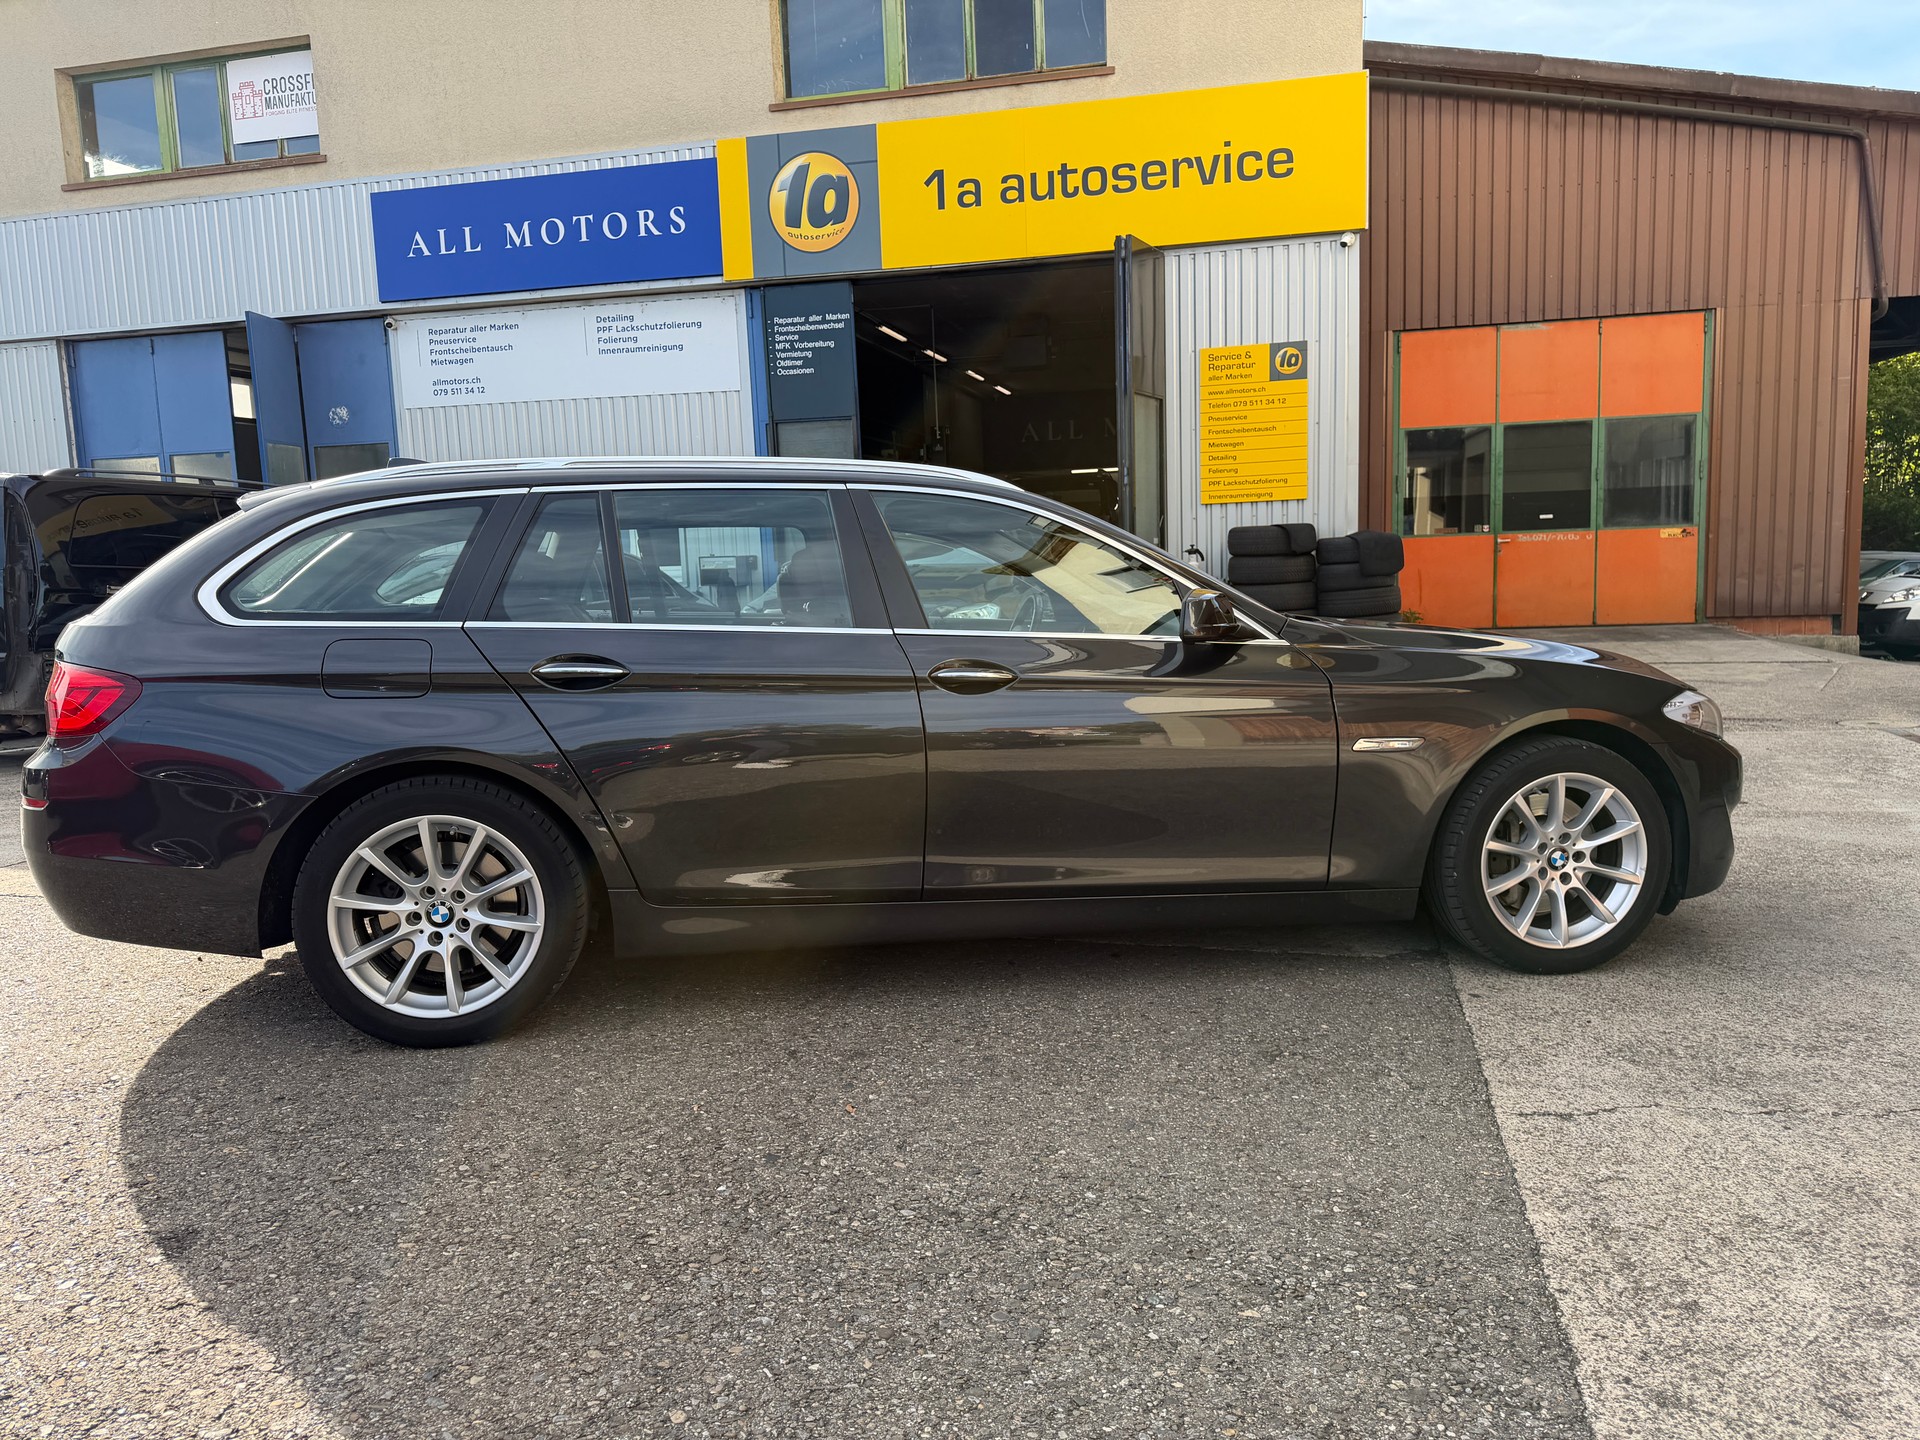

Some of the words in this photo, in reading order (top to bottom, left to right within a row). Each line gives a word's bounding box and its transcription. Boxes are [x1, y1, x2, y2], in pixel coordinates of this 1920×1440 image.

[265, 109, 285, 117] FORGING
[924, 169, 981, 210] 1a
[1000, 141, 1294, 204] autoservice
[777, 162, 849, 229] 1a
[407, 226, 481, 257] ALL
[504, 206, 686, 248] MOTORS
[787, 227, 845, 240] autoservice
[596, 314, 634, 323] Detailing
[773, 316, 805, 325] Reparatur
[825, 313, 850, 321] Marken
[428, 326, 467, 336] Reparatur
[469, 324, 487, 333] aller
[489, 322, 519, 331] Marken
[596, 325, 613, 334] PPF
[615, 321, 702, 333] Lackschutzfolierung
[774, 321, 845, 333] Frontscheibenwechsel
[429, 335, 477, 346] Pneuservice
[597, 335, 638, 344] Folierung
[775, 334, 799, 342] Service
[430, 343, 513, 356] Frontscheibentausch
[598, 343, 684, 355] Innenraumreinigung
[775, 342, 791, 350] MFK
[794, 340, 834, 348] Vorbereitung
[775, 350, 812, 358] Vermietung
[1208, 352, 1242, 362] Service
[1244, 351, 1252, 359] &
[1278, 350, 1299, 368] 1a
[430, 357, 474, 366] Mietwagen
[776, 359, 803, 367] Oldtimer
[1208, 361, 1256, 372] Reparatur
[777, 367, 814, 375] Occasionen
[432, 376, 481, 386] allmotors.ch
[433, 388, 448, 396] 079
[477, 386, 485, 394] 12
[1208, 386, 1266, 396] www.allmotors.ch
[1233, 400, 1248, 408] 079
[1208, 414, 1247, 422] Pneuservice
[1022, 420, 1083, 442] ALL
[1208, 425, 1277, 435] Frontscheibentausch
[1223, 477, 1288, 486] Lackschutzfolierung
[1208, 491, 1273, 500] Innenraumreinigung
